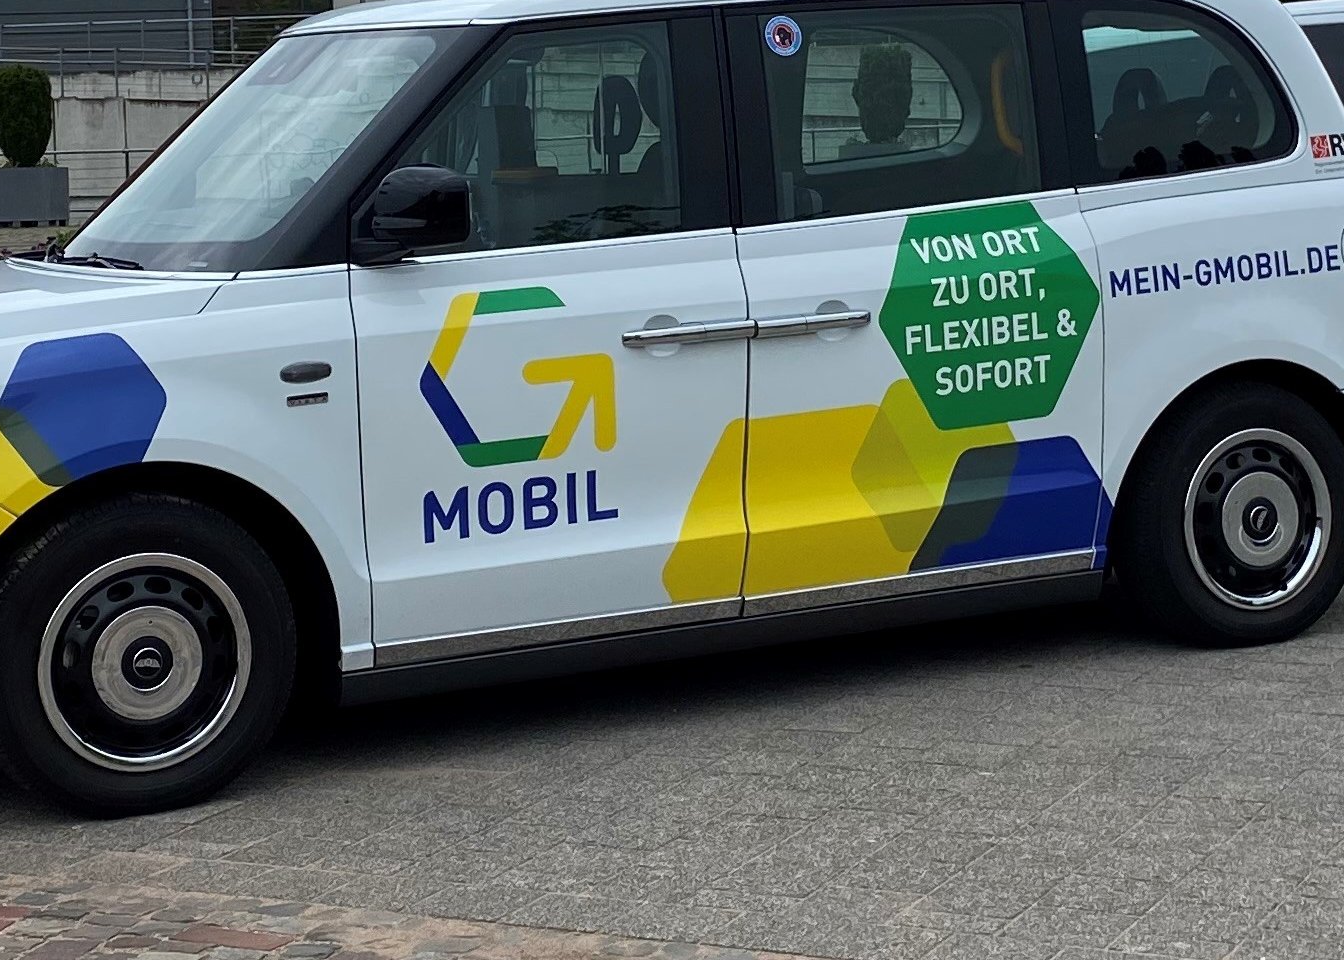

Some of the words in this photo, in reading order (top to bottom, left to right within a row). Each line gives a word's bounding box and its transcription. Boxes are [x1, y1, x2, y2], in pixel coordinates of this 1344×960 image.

[909, 233, 977, 264] VON
[981, 226, 1041, 257] ORT
[930, 274, 970, 307] ZU
[978, 267, 1047, 302] ORT,
[1109, 244, 1341, 298] MEIN-GMOBIL.DE
[905, 311, 1049, 355] FLEXIBEL
[1056, 308, 1078, 338] &
[935, 354, 1051, 396] SOFORT
[423, 469, 619, 544] MOBIL
